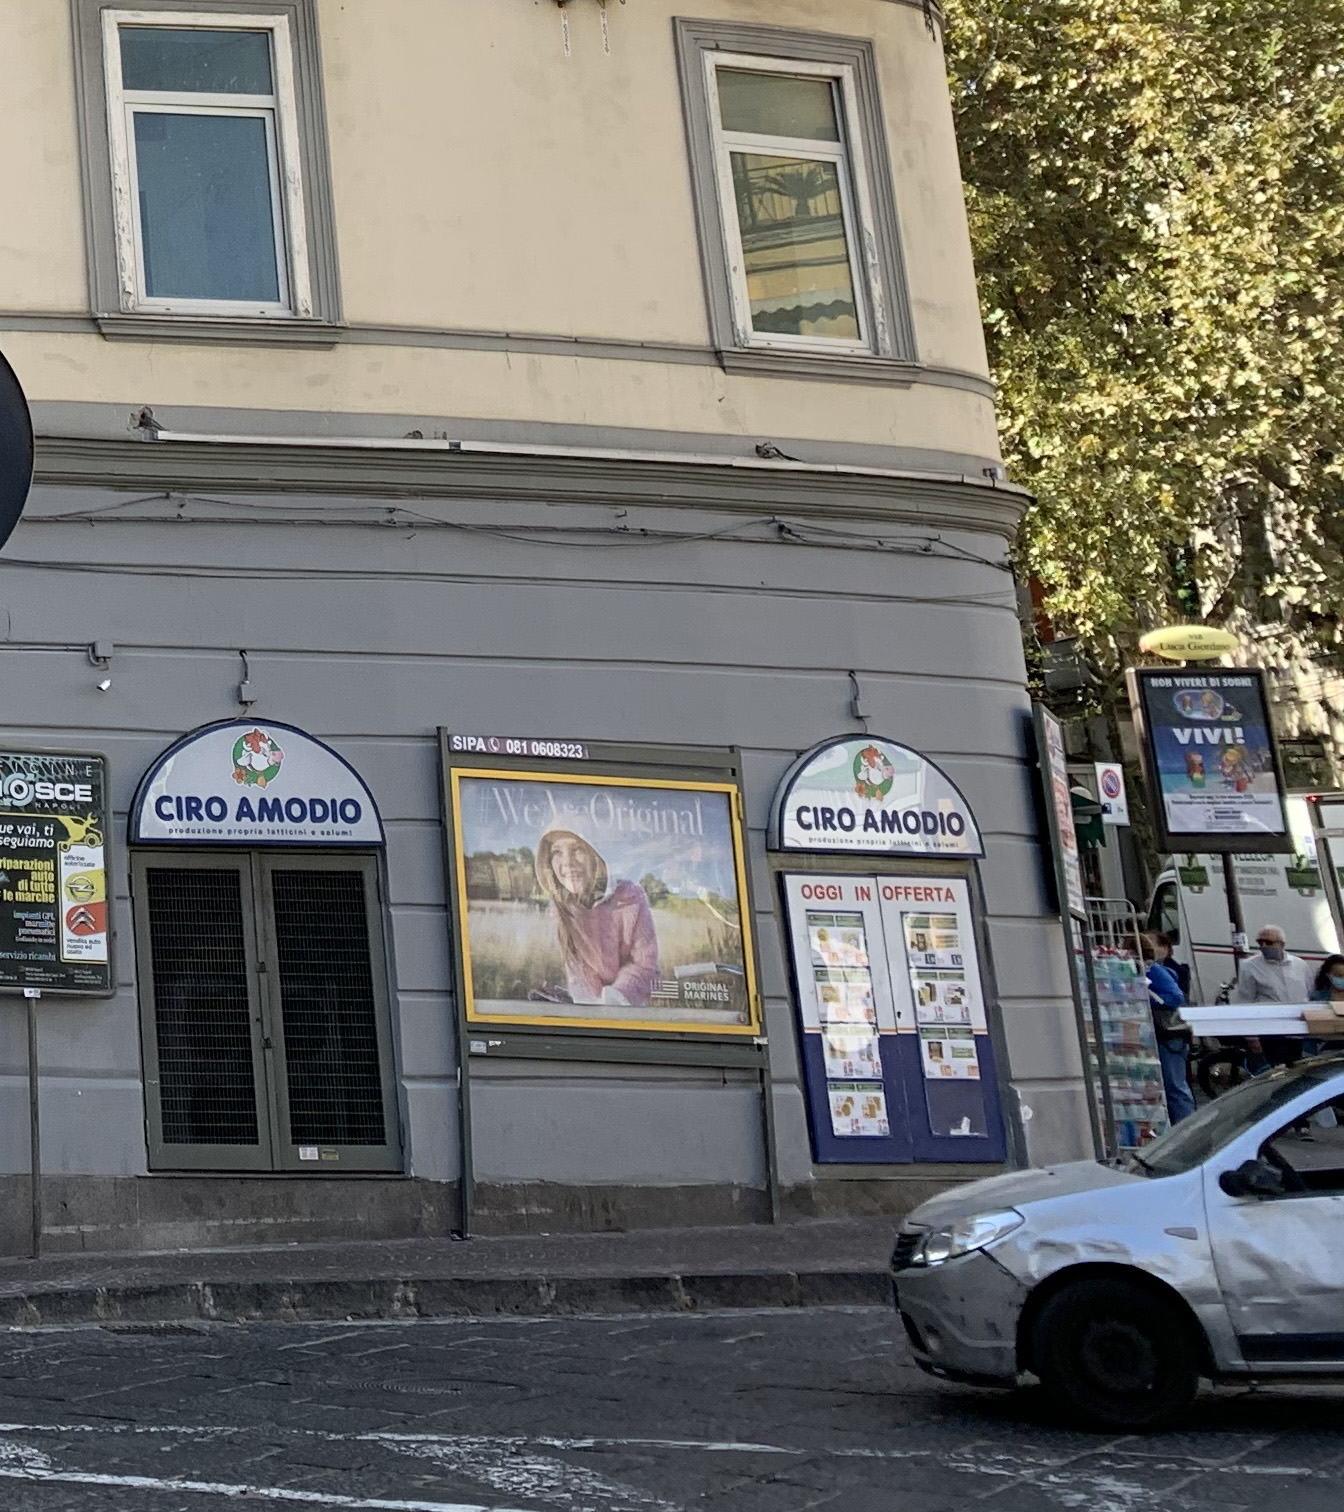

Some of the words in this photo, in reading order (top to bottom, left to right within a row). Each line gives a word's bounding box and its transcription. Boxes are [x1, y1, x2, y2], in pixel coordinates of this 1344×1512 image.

[1160, 642, 1185, 651] Luca
[1187, 641, 1231, 651] Giordano
[1150, 677, 1173, 687] NON
[1175, 677, 1208, 687] VIVERE
[1209, 677, 1221, 687] DI
[1222, 677, 1253, 687] SOGNI
[1172, 726, 1246, 745] VIVI!
[453, 735, 487, 752] SIPA
[505, 738, 528, 755] 081
[531, 740, 584, 759] 0608323
[35, 802, 81, 810] NAPOLI
[154, 794, 228, 823] CIRO
[235, 796, 362, 825] AMODIO
[796, 805, 856, 832] CIRO
[863, 808, 965, 837] AMODIO
[16, 823, 41, 837] vai,
[44, 824, 54, 837] ti
[168, 827, 223, 835] produzione
[227, 827, 263, 836] propria
[808, 837, 853, 845] produzione
[31, 871, 55, 882] auto
[18, 879, 28, 891] di
[30, 881, 55, 893] tutte
[3, 889, 13, 901] le
[15, 891, 55, 903] marche
[801, 884, 843, 901] OGGI
[855, 885, 872, 902] IN
[882, 885, 957, 903] OFFERTA
[28, 951, 56, 961] ricambi
[684, 981, 729, 993] ORIGINAL
[684, 990, 730, 1001] MARINES
